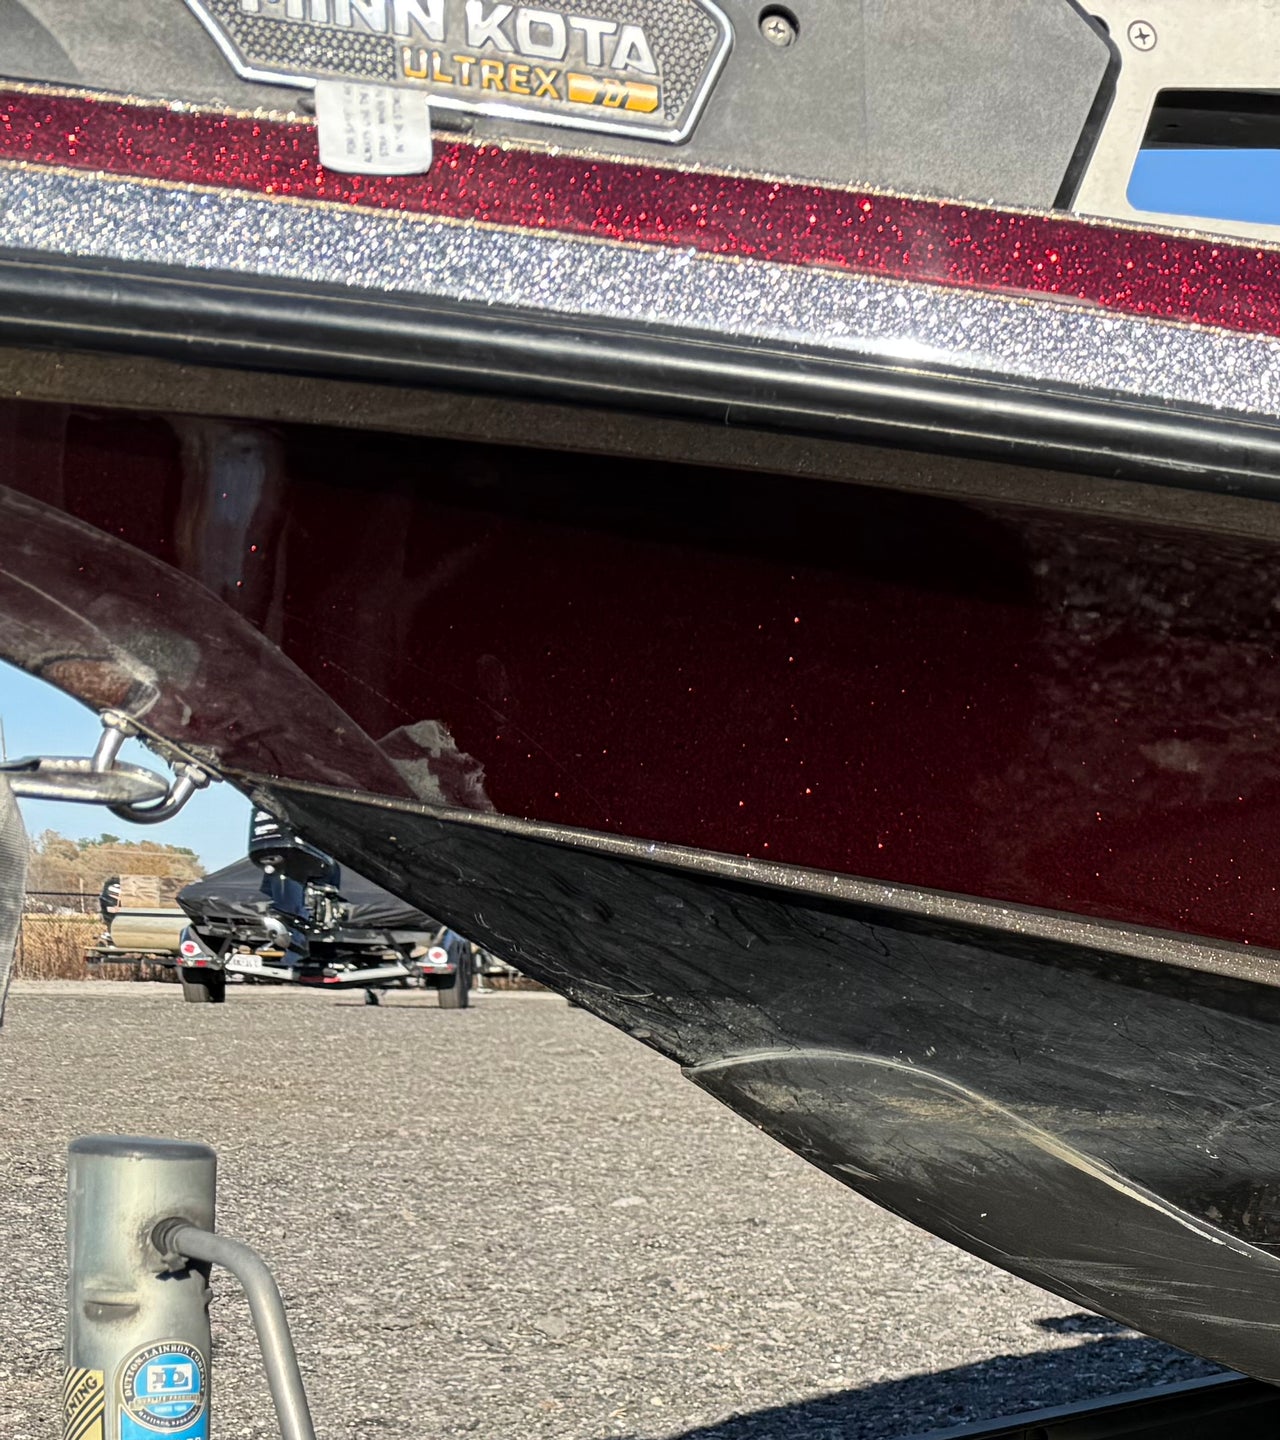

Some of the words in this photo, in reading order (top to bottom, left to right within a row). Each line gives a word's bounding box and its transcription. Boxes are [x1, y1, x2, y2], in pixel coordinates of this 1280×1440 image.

[241, 0, 445, 42] INN
[465, 0, 658, 75] KOTA
[402, 46, 561, 100] ULTREX
